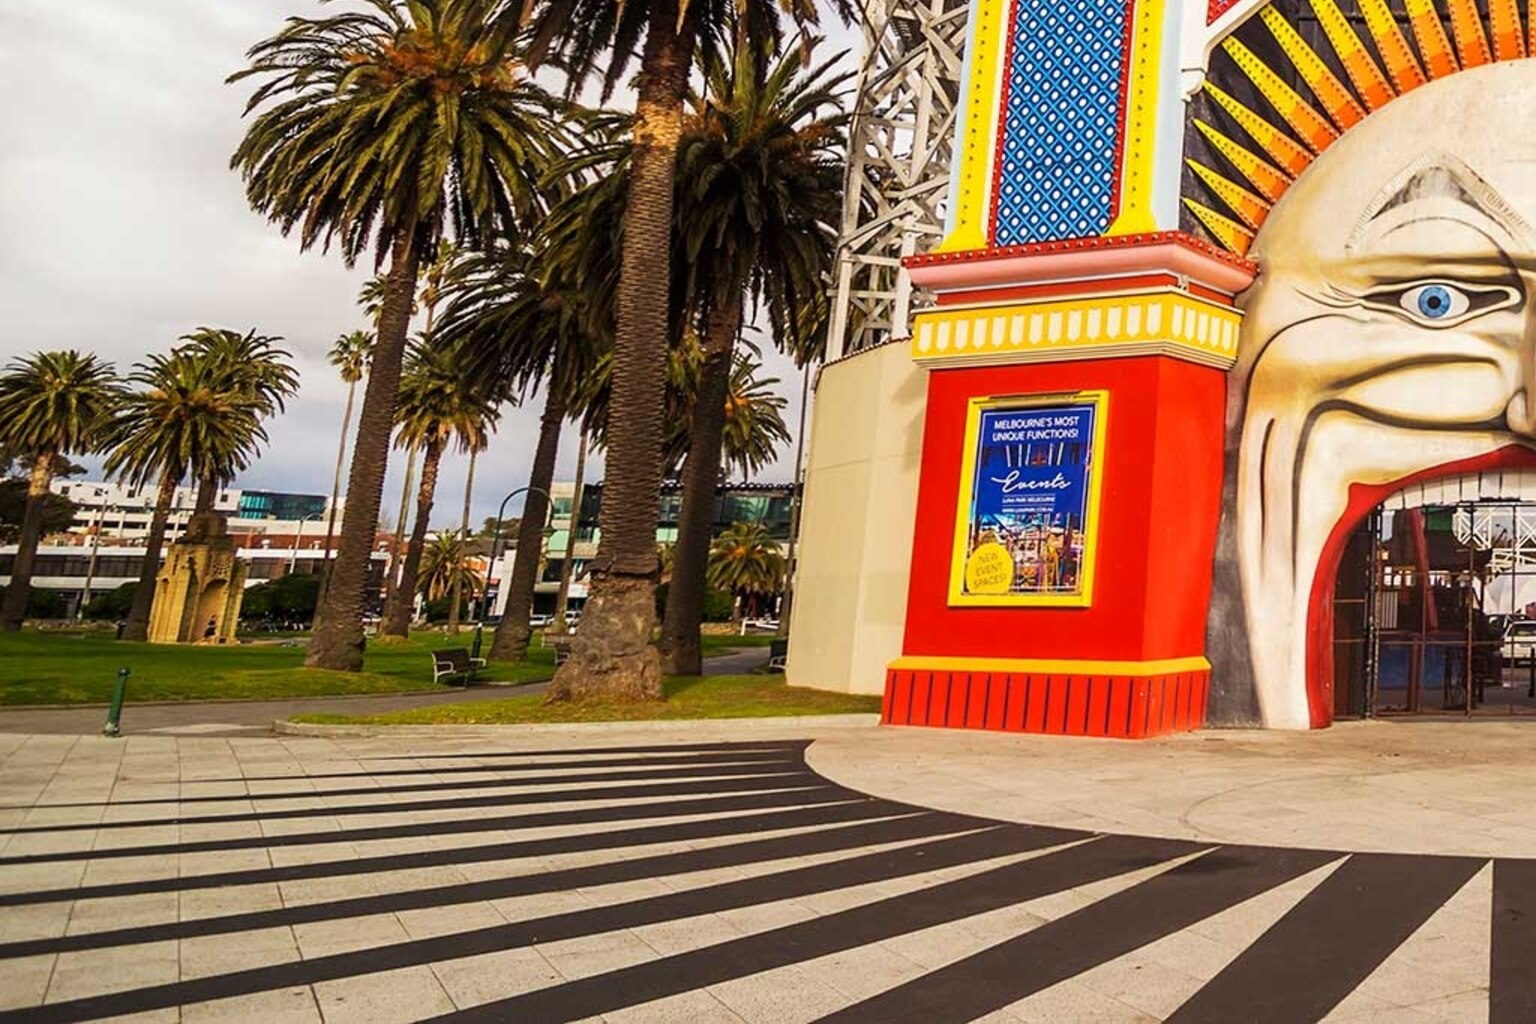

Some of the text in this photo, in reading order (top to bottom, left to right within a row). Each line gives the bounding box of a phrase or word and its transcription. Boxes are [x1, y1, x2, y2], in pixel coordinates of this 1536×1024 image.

[994, 415, 1080, 430] MELBOURNE'S MOST
[992, 428, 1079, 442] UNIQUE FUNCTIONS!
[990, 469, 1072, 494] Events
